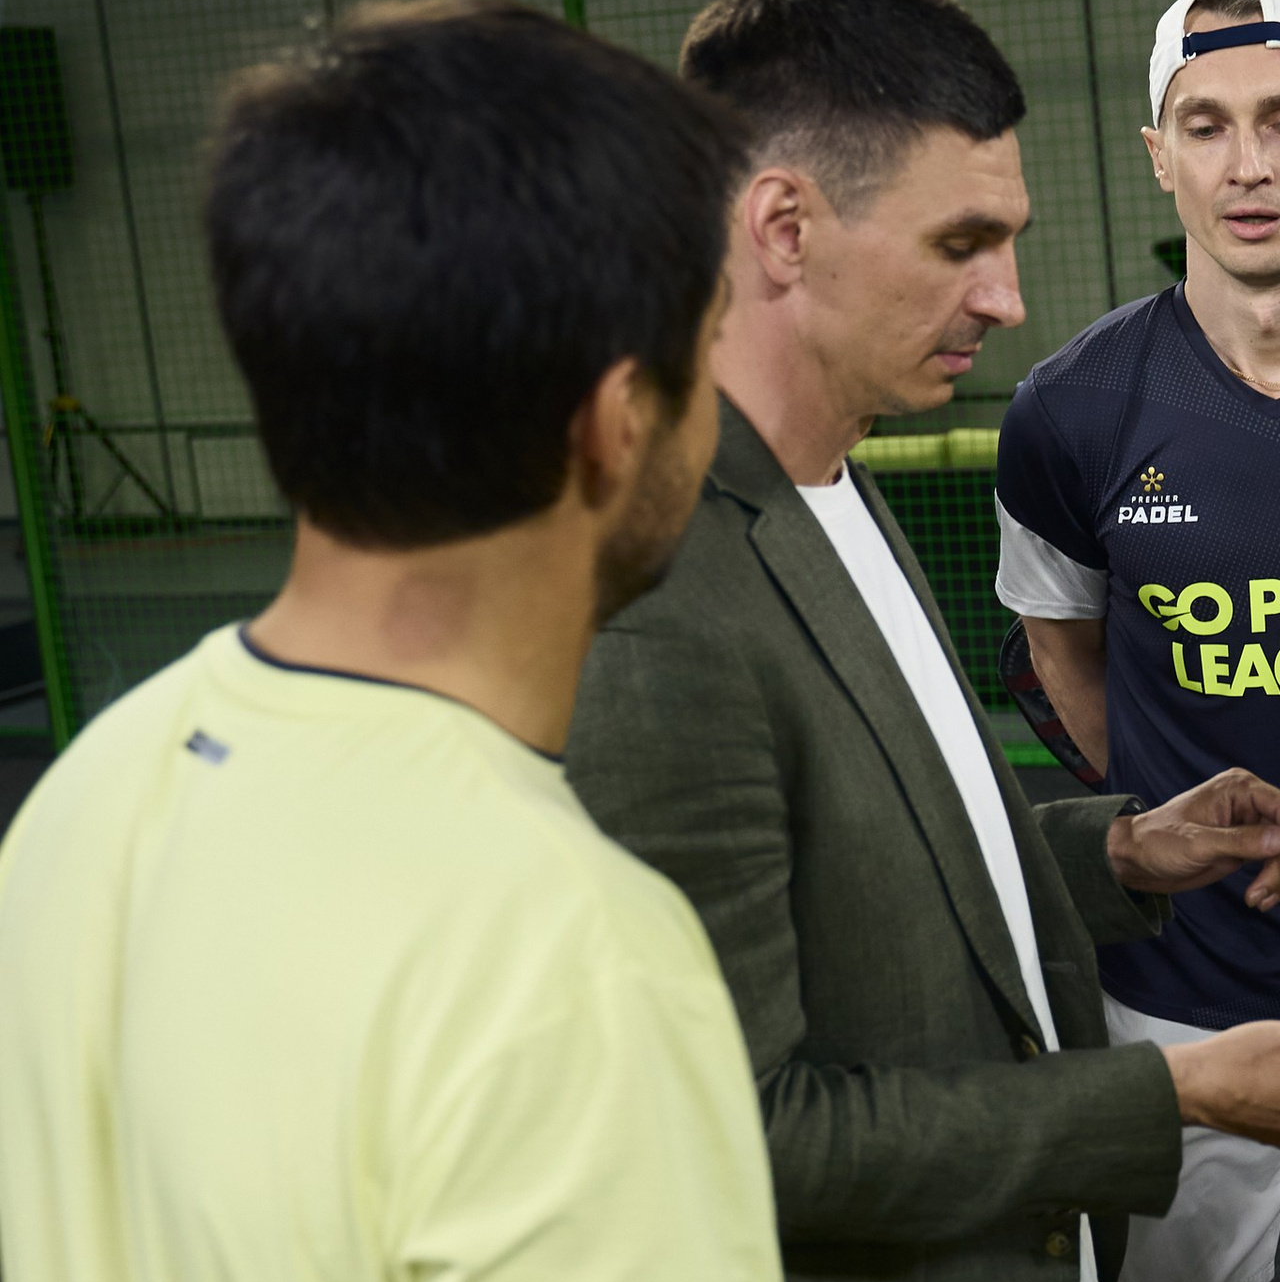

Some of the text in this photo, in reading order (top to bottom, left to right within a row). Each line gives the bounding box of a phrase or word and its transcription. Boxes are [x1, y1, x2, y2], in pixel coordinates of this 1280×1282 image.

[1131, 494, 1179, 504] PREMIER
[1118, 504, 1199, 524] PADEL
[1137, 581, 1234, 636] GO
